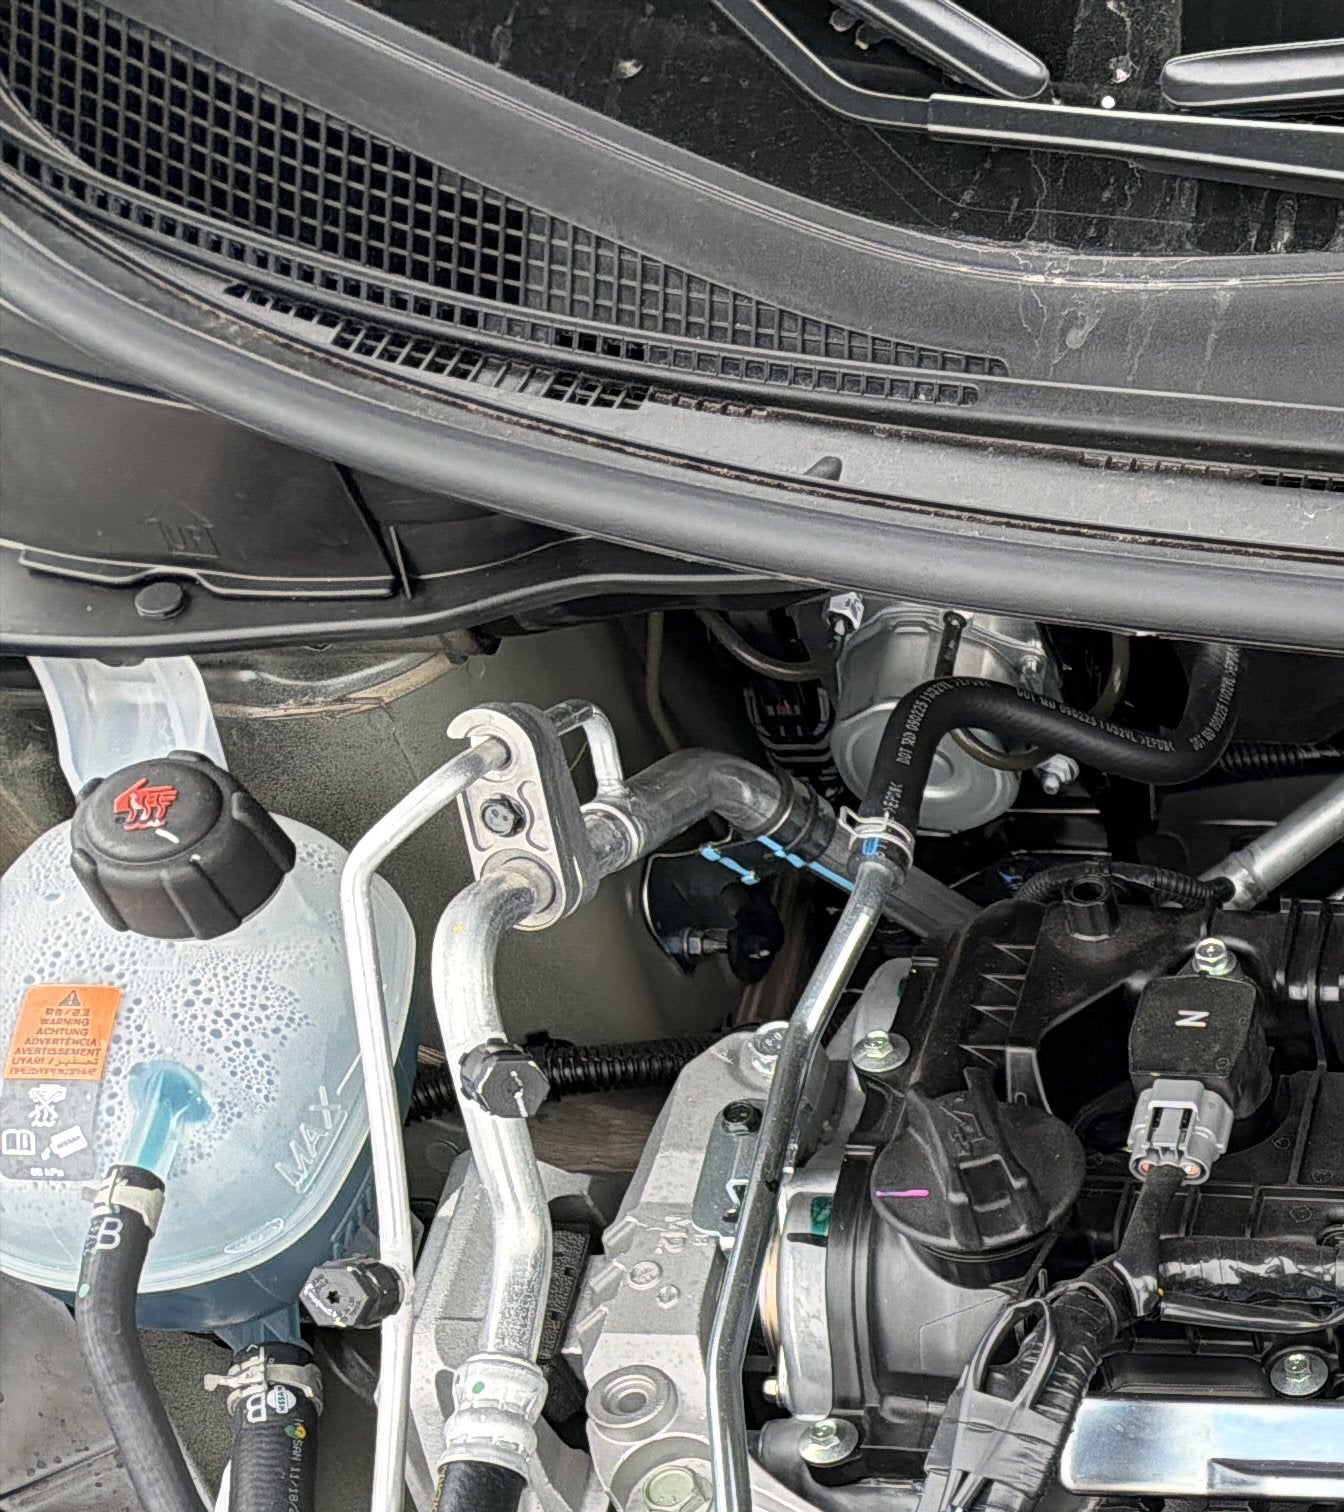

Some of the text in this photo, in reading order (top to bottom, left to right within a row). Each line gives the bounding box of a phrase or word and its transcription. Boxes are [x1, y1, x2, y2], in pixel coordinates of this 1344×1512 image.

[896, 746, 912, 766] DOT
[36, 1027, 89, 1037] ACHTUNG
[41, 1018, 89, 1027] WARNING
[15, 1047, 101, 1057] AVERTISSEMENT
[275, 1086, 342, 1193] MAX
[92, 1217, 124, 1255] B
[246, 1392, 268, 1424] B
